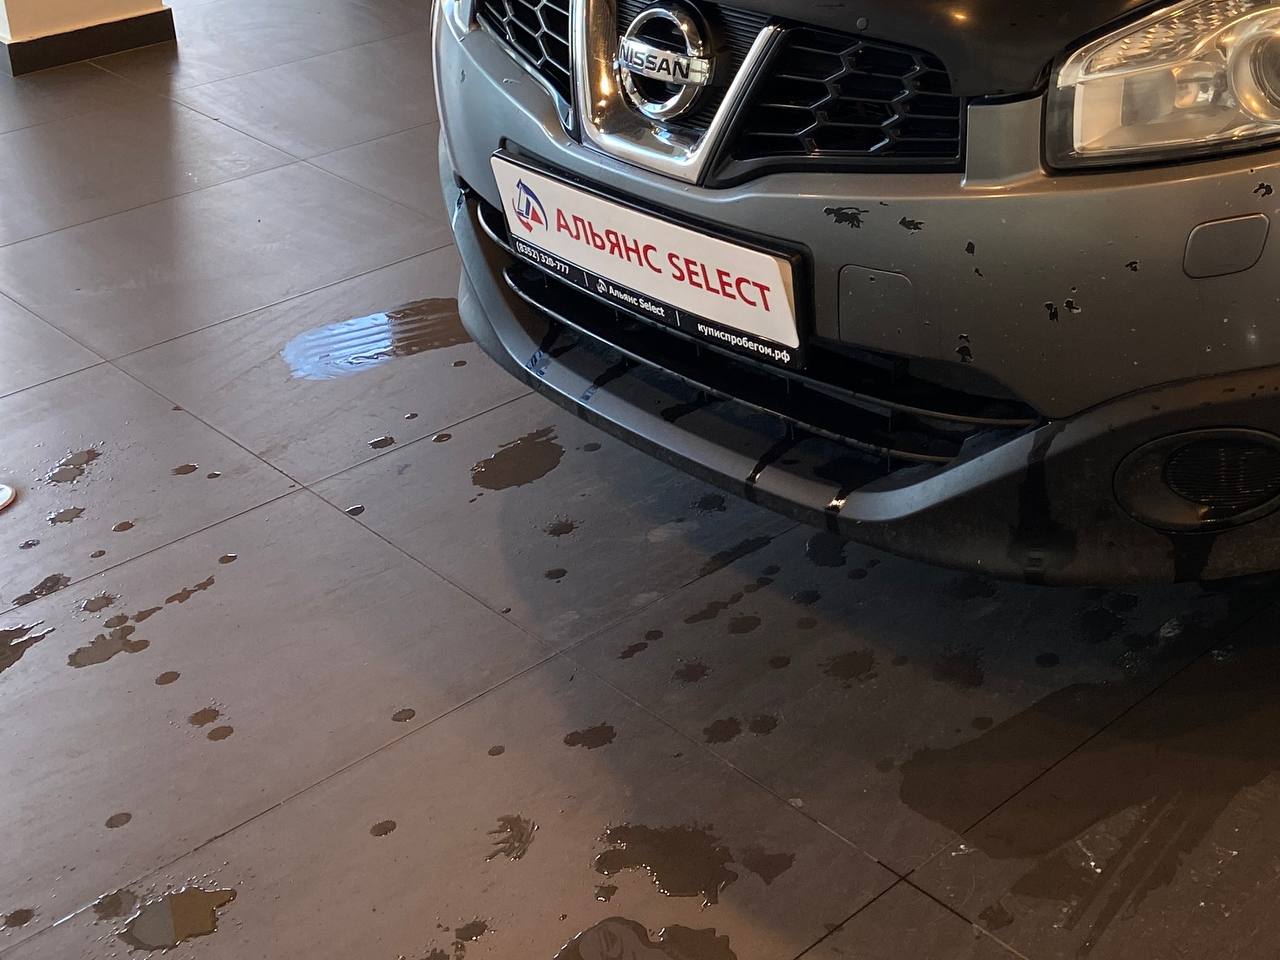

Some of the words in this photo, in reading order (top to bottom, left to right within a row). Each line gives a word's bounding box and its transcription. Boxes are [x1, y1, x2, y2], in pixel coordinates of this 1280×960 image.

[620, 44, 690, 79] NISSAN
[516, 241, 540, 262] (8352)
[541, 252, 570, 275] 320-777
[556, 208, 662, 274] АЛЬЯНС
[667, 252, 771, 313] SELECT
[609, 286, 639, 306] Альянс
[639, 298, 666, 317] Select
[697, 323, 791, 364] куписпробегом.рф
